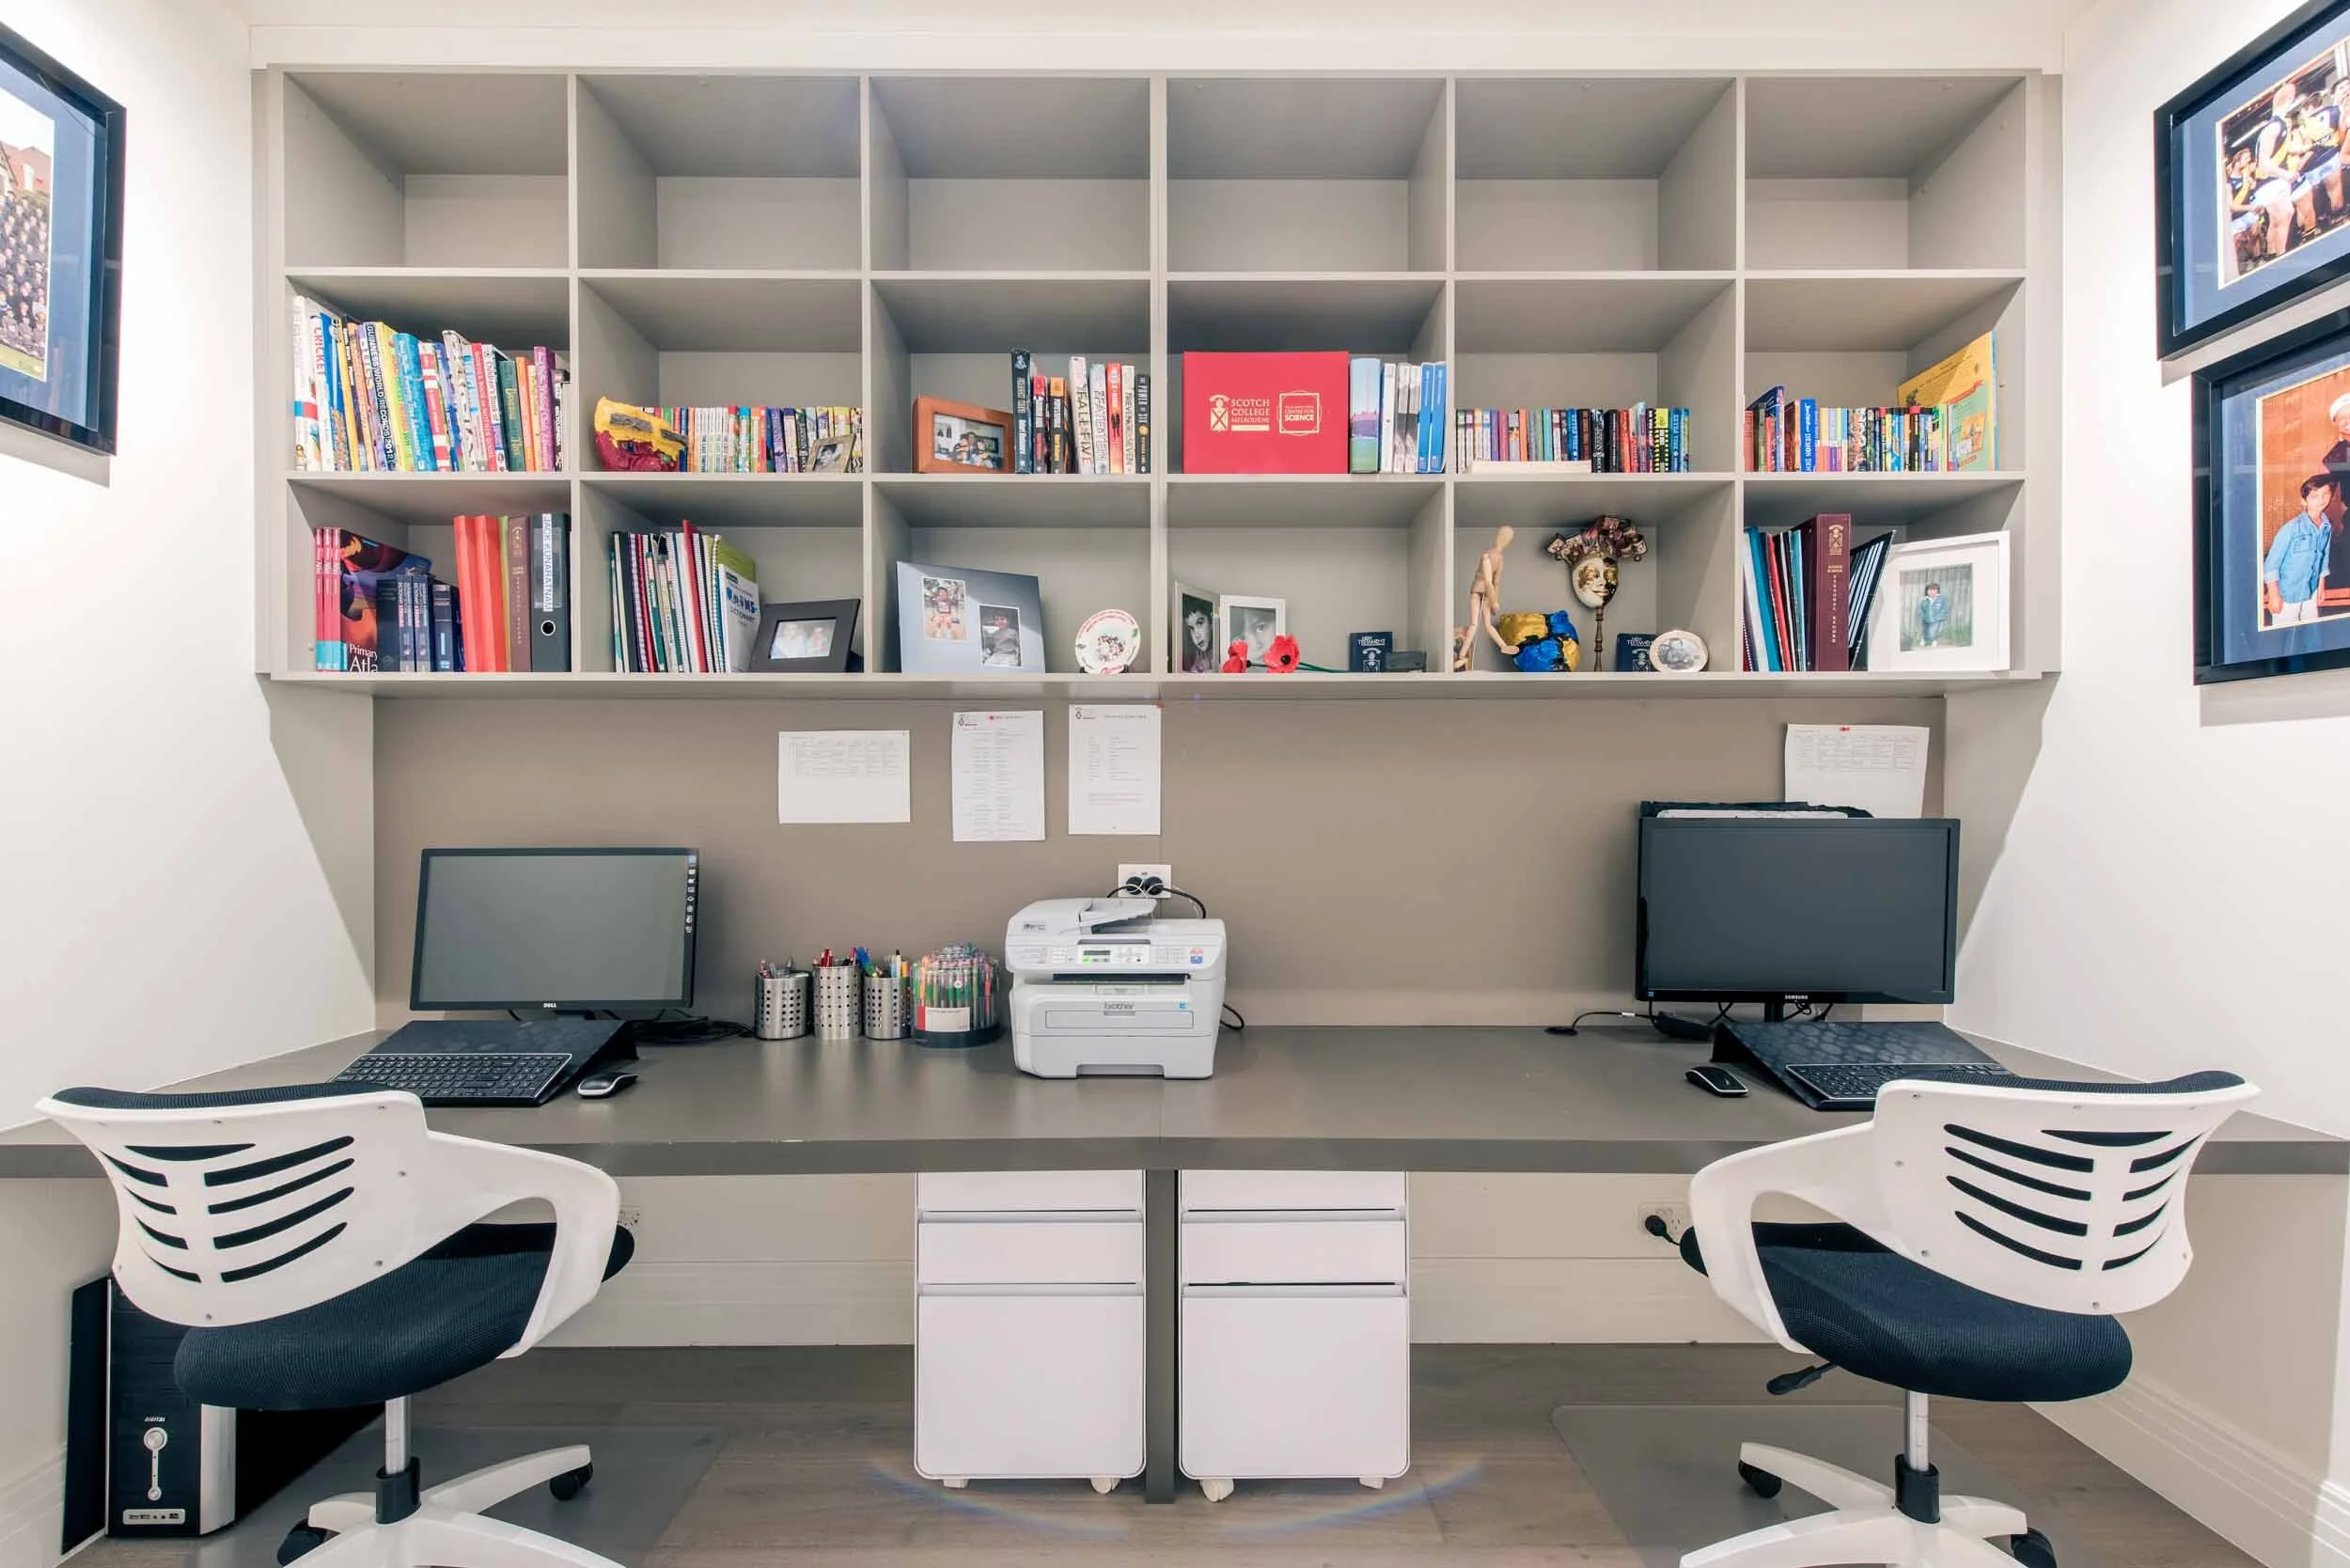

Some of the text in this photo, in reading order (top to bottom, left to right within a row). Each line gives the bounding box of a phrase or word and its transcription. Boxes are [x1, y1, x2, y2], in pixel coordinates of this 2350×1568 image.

[314, 326, 325, 376] CRICKET
[485, 361, 494, 396] Children's
[367, 325, 395, 460] GUINNESS WORLD RECORDS 2012
[1137, 384, 1148, 405] POWER
[1231, 399, 1270, 407] SCOTCH
[1137, 413, 1148, 424] SIX
[1080, 432, 1091, 465] FIVE
[1804, 433, 1812, 457] DEMON
[1804, 459, 1812, 472] DEN
[543, 517, 553, 542] JACK
[349, 643, 378, 661] Primary
[349, 654, 378, 673] Atla
[1104, 1000, 1135, 1010] brother
